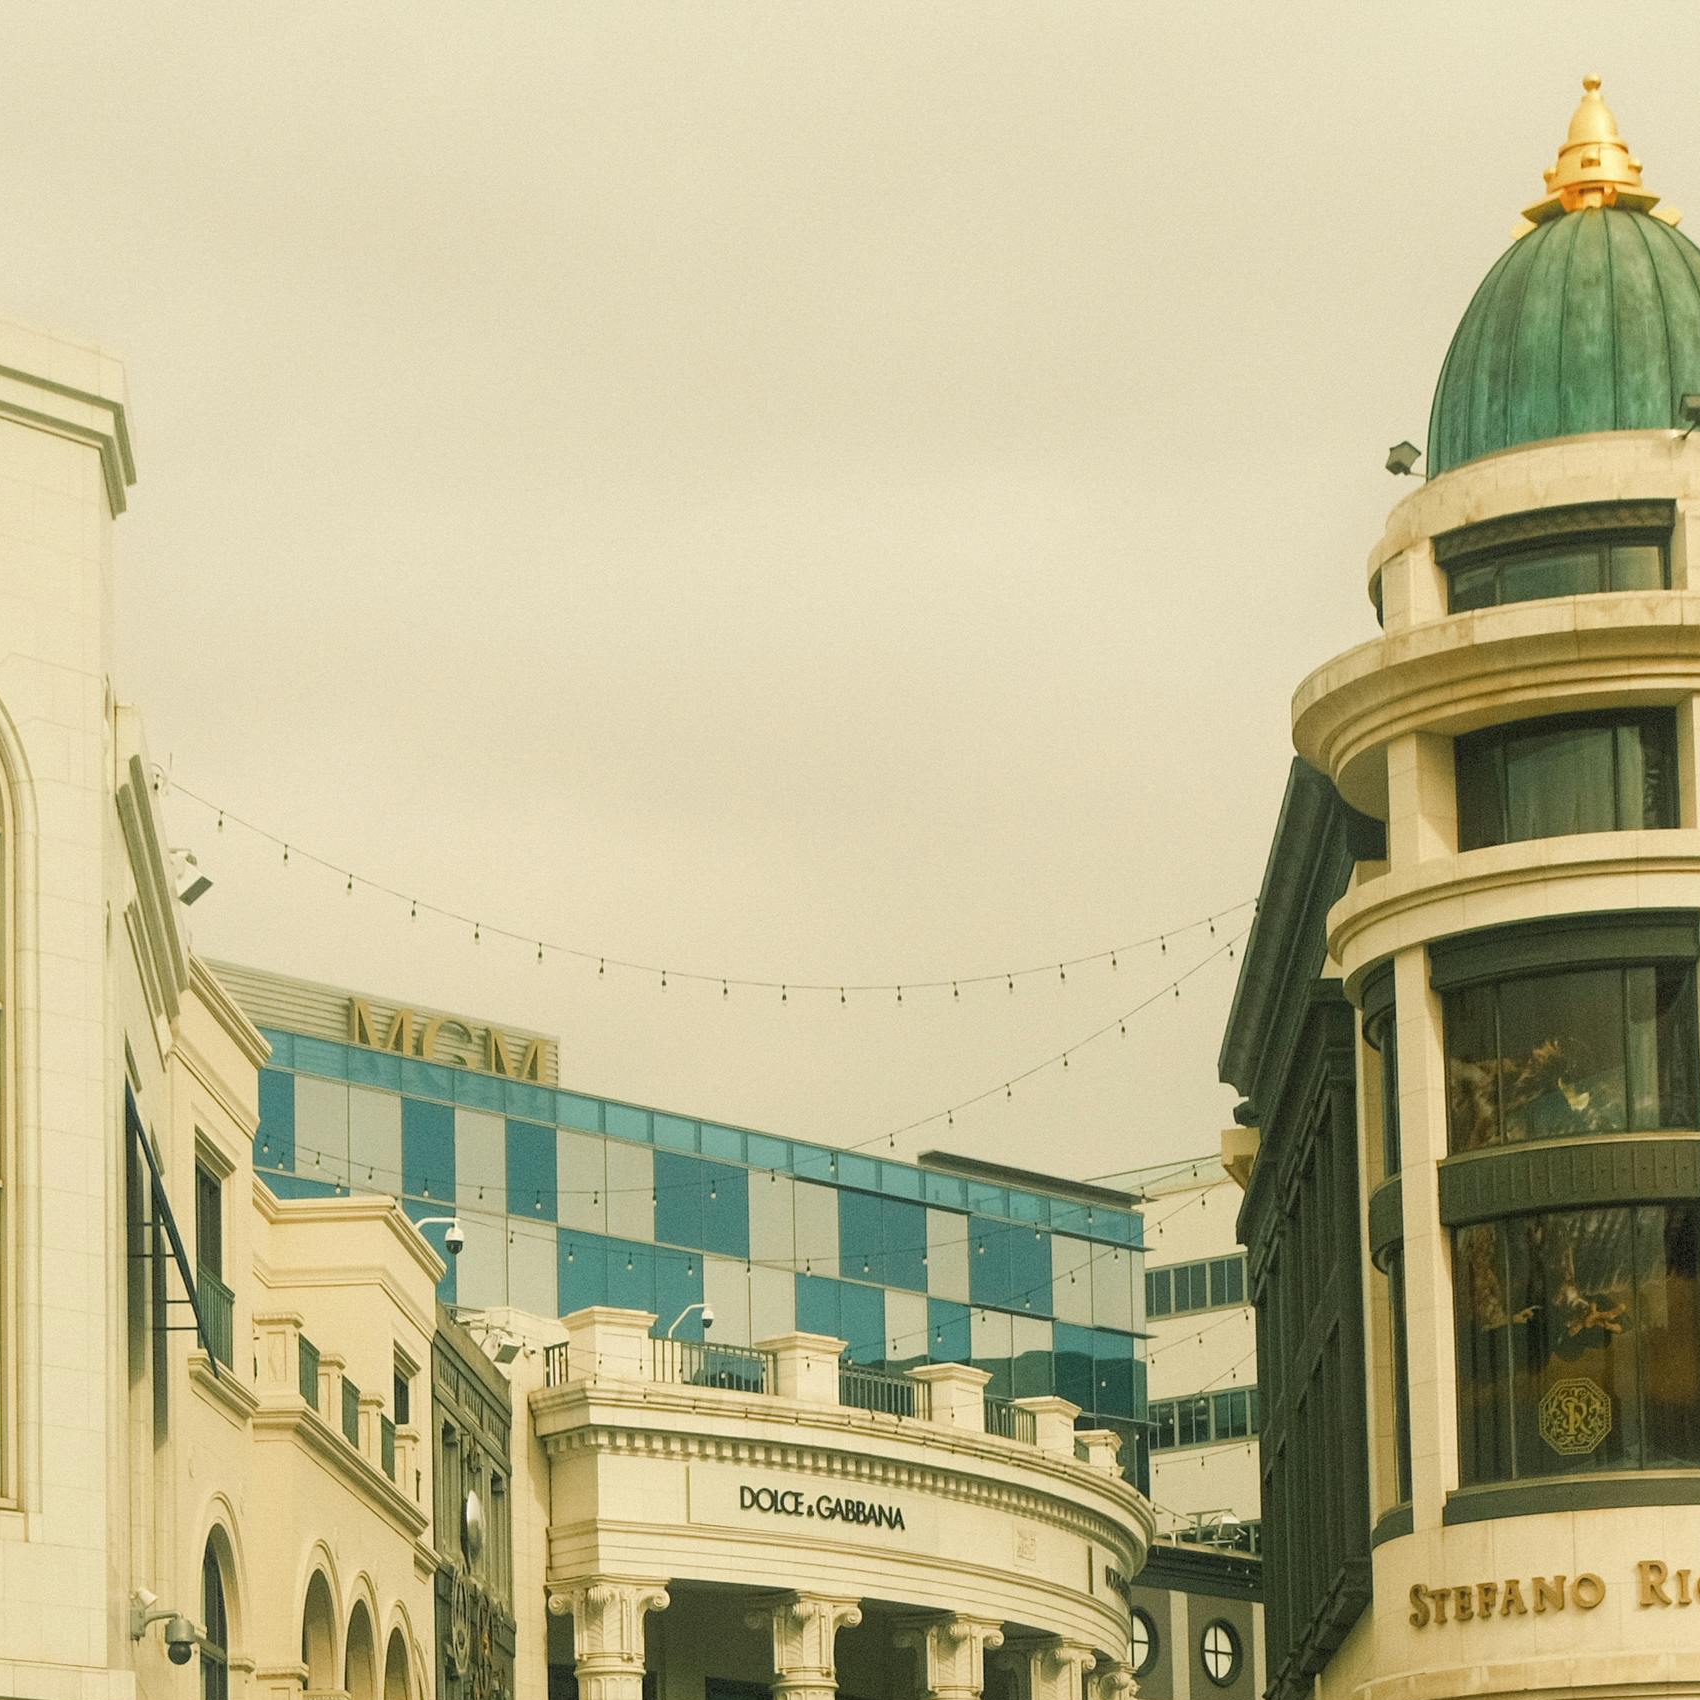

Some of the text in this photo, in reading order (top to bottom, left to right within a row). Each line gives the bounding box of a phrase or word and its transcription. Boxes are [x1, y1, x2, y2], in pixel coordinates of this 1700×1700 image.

[347, 997, 548, 1083] MGM
[740, 1485, 906, 1531] DOLCE & GABBANA
[1409, 1573, 1606, 1628] STEFANO
